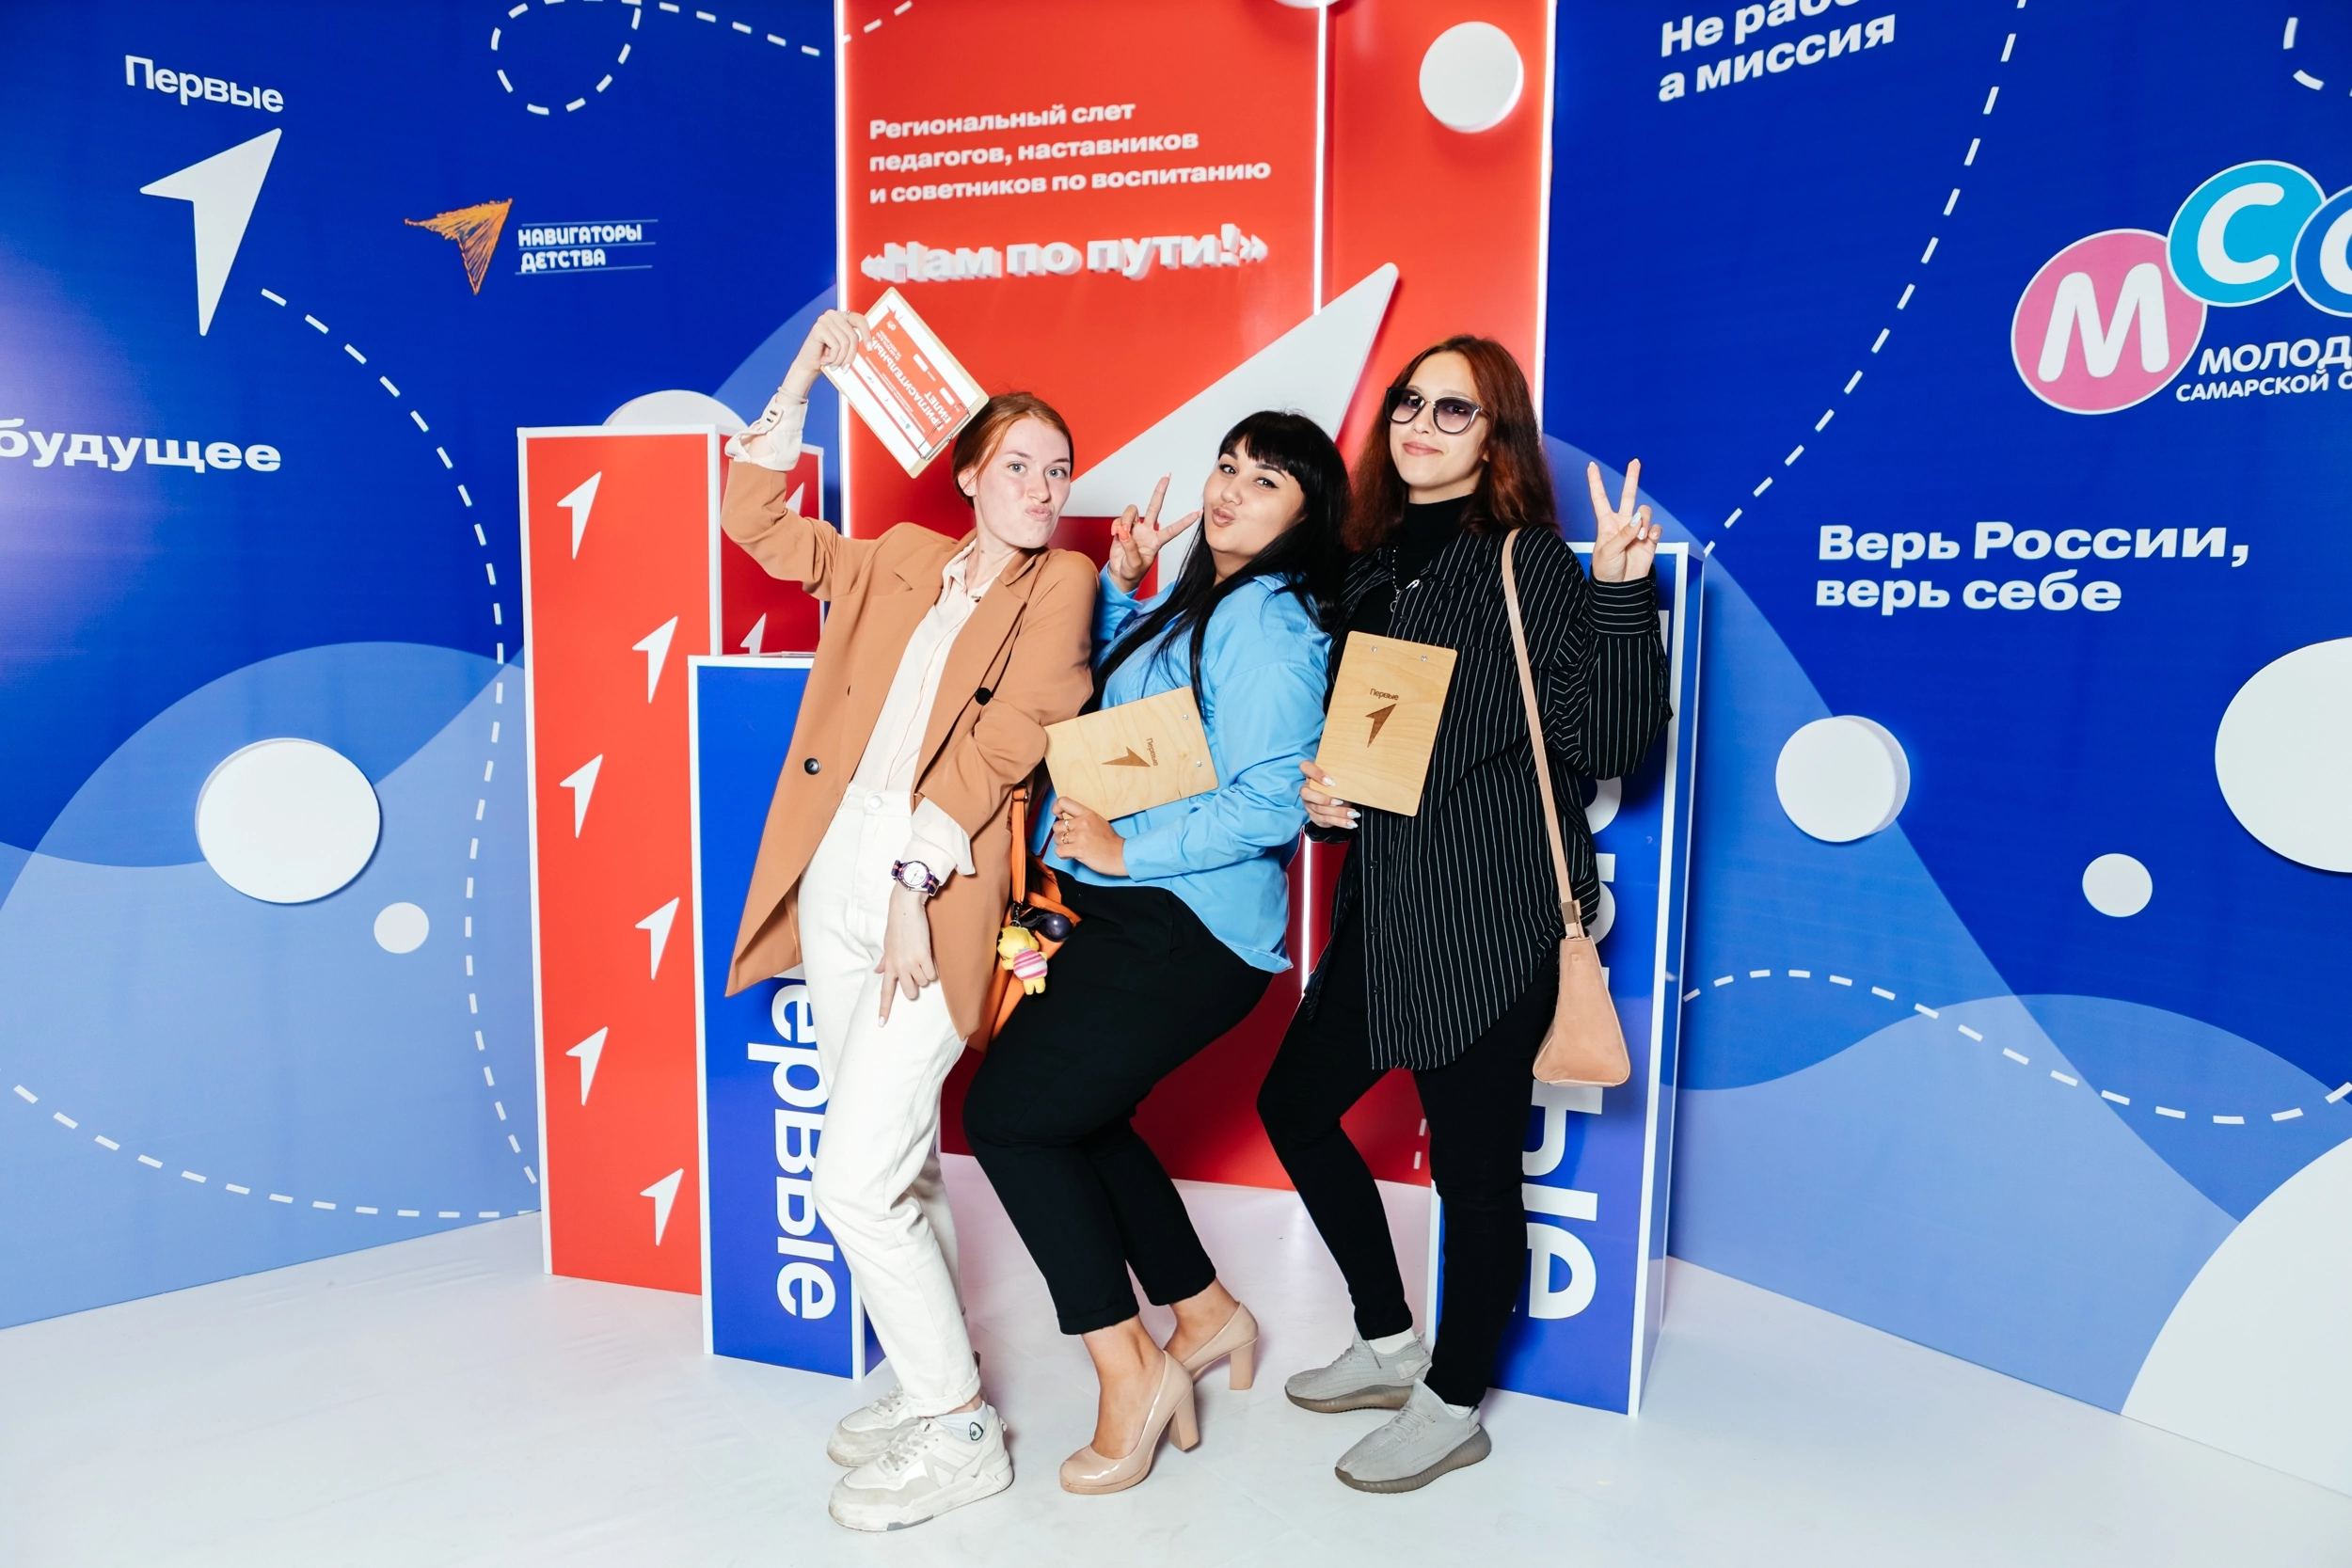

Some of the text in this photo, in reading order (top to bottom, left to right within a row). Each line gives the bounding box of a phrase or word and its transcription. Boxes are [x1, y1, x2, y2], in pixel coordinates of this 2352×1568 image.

[1661, 15, 1724, 57] Не
[1659, 14, 1896, 103] а миссия
[125, 55, 284, 113] Первые
[870, 103, 1136, 140] Региональный слет
[870, 132, 1200, 172] педагогов, наставников
[870, 162, 1272, 204] и советников по воспитанию
[517, 224, 643, 247] НАВИГАТОРЫ
[1006, 241, 1082, 277] по
[1087, 223, 1268, 280] пути!»
[520, 248, 607, 273] ДЕТСТВА
[2175, 369, 2329, 402] САМАРСКОЙ
[1818, 522, 2249, 569] Верь России,
[1816, 570, 2122, 616] верь себе
[1369, 688, 1400, 702] Первые
[747, 964, 836, 1320] ервые
